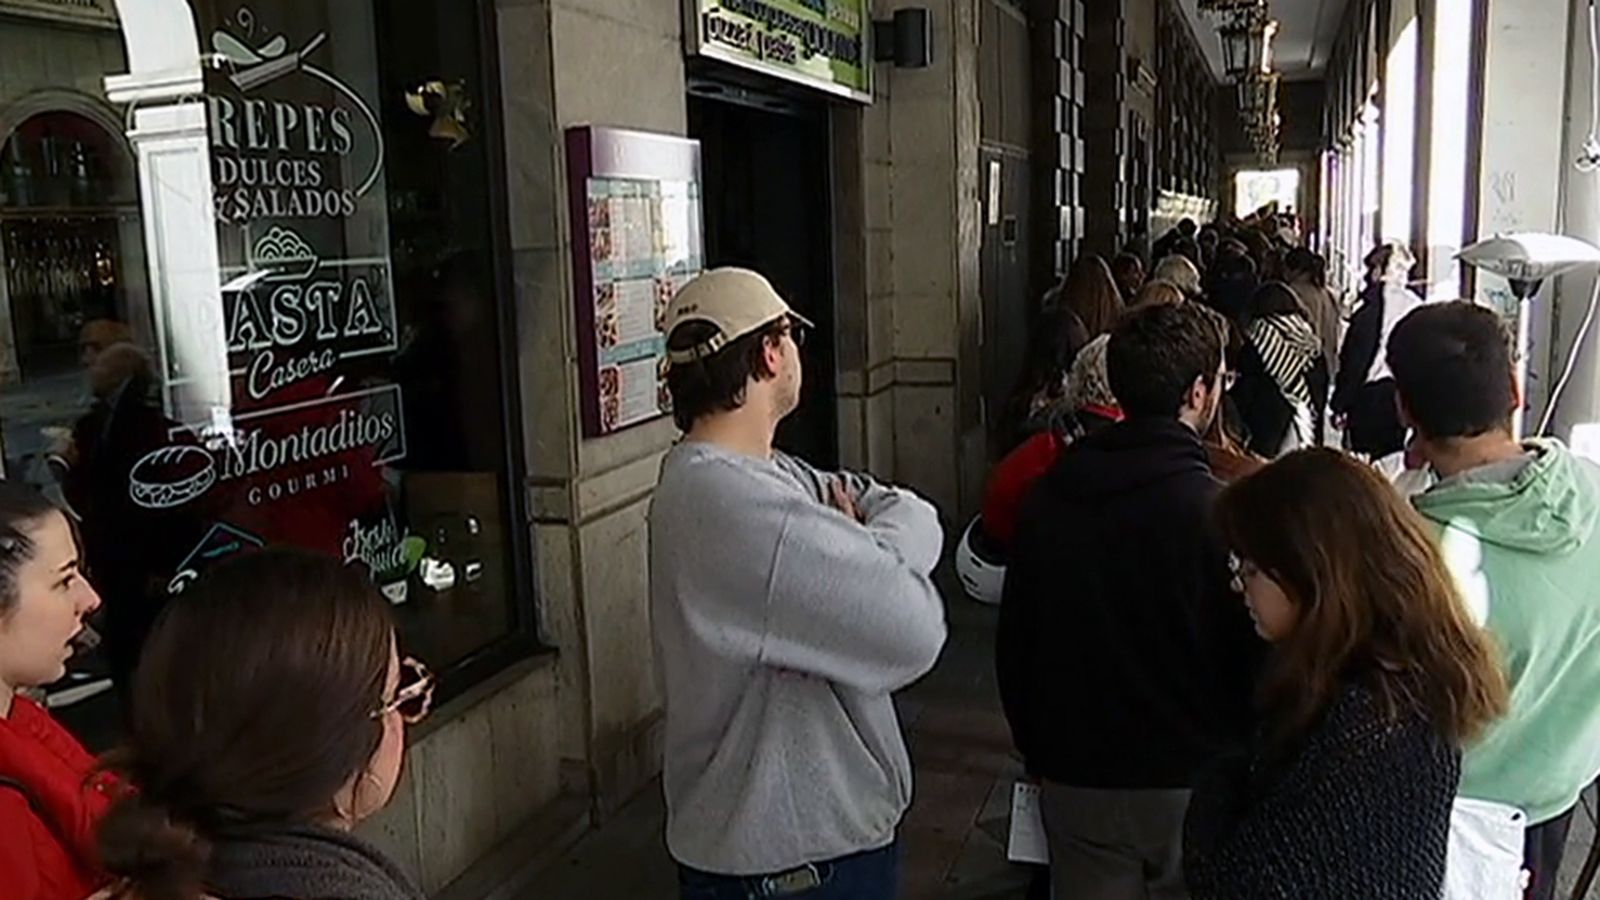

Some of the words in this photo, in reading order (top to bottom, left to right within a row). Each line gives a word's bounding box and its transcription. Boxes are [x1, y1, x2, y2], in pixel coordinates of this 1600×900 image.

[206, 94, 352, 155] REPES
[216, 156, 322, 187] DULCES
[233, 187, 355, 220] SALADOS
[226, 278, 382, 351] ASTA
[249, 350, 335, 399] Casera
[220, 409, 394, 481] Montaditos
